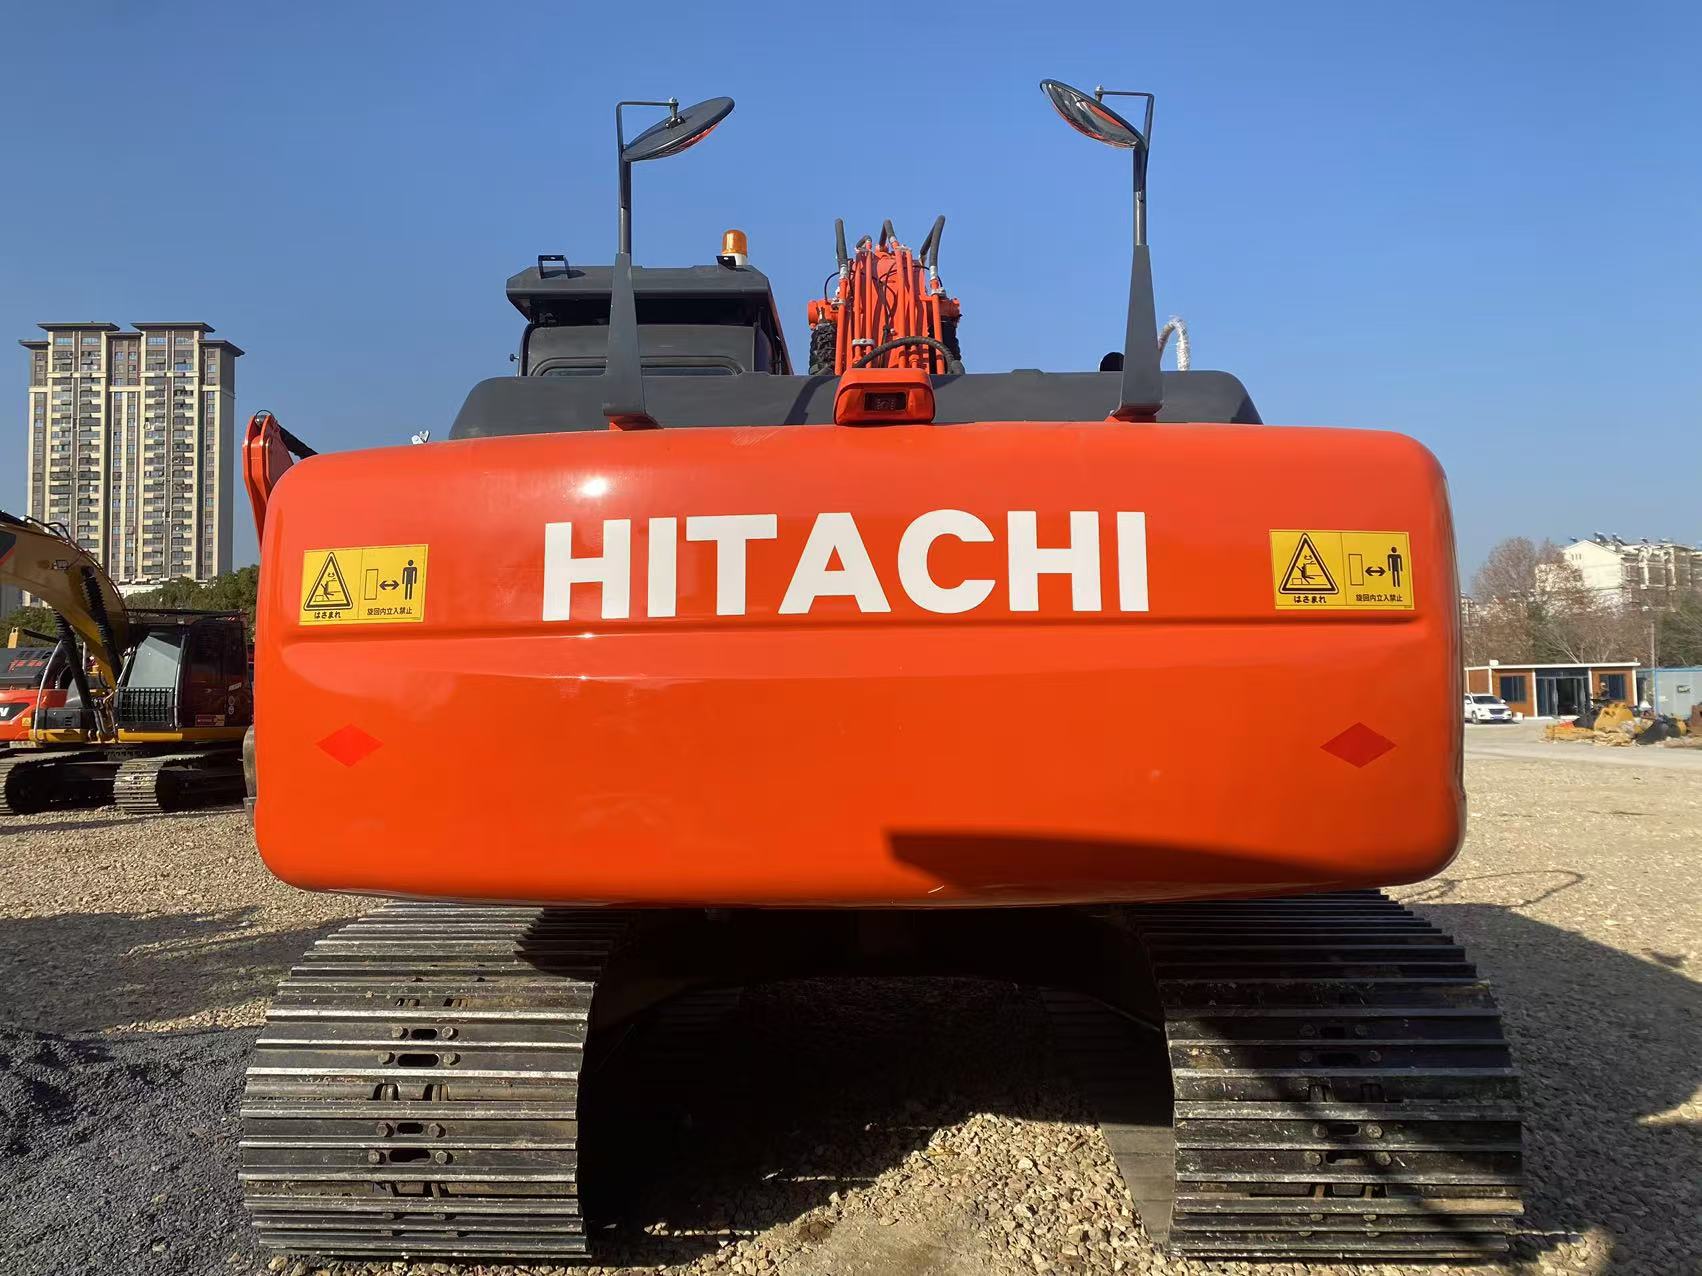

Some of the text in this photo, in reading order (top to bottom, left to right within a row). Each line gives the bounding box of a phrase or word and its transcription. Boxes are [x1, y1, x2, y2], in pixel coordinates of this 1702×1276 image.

[541, 509, 1149, 622] HITACHI
[1293, 595, 1327, 604] はさまれ
[314, 610, 341, 620] はさまれ
